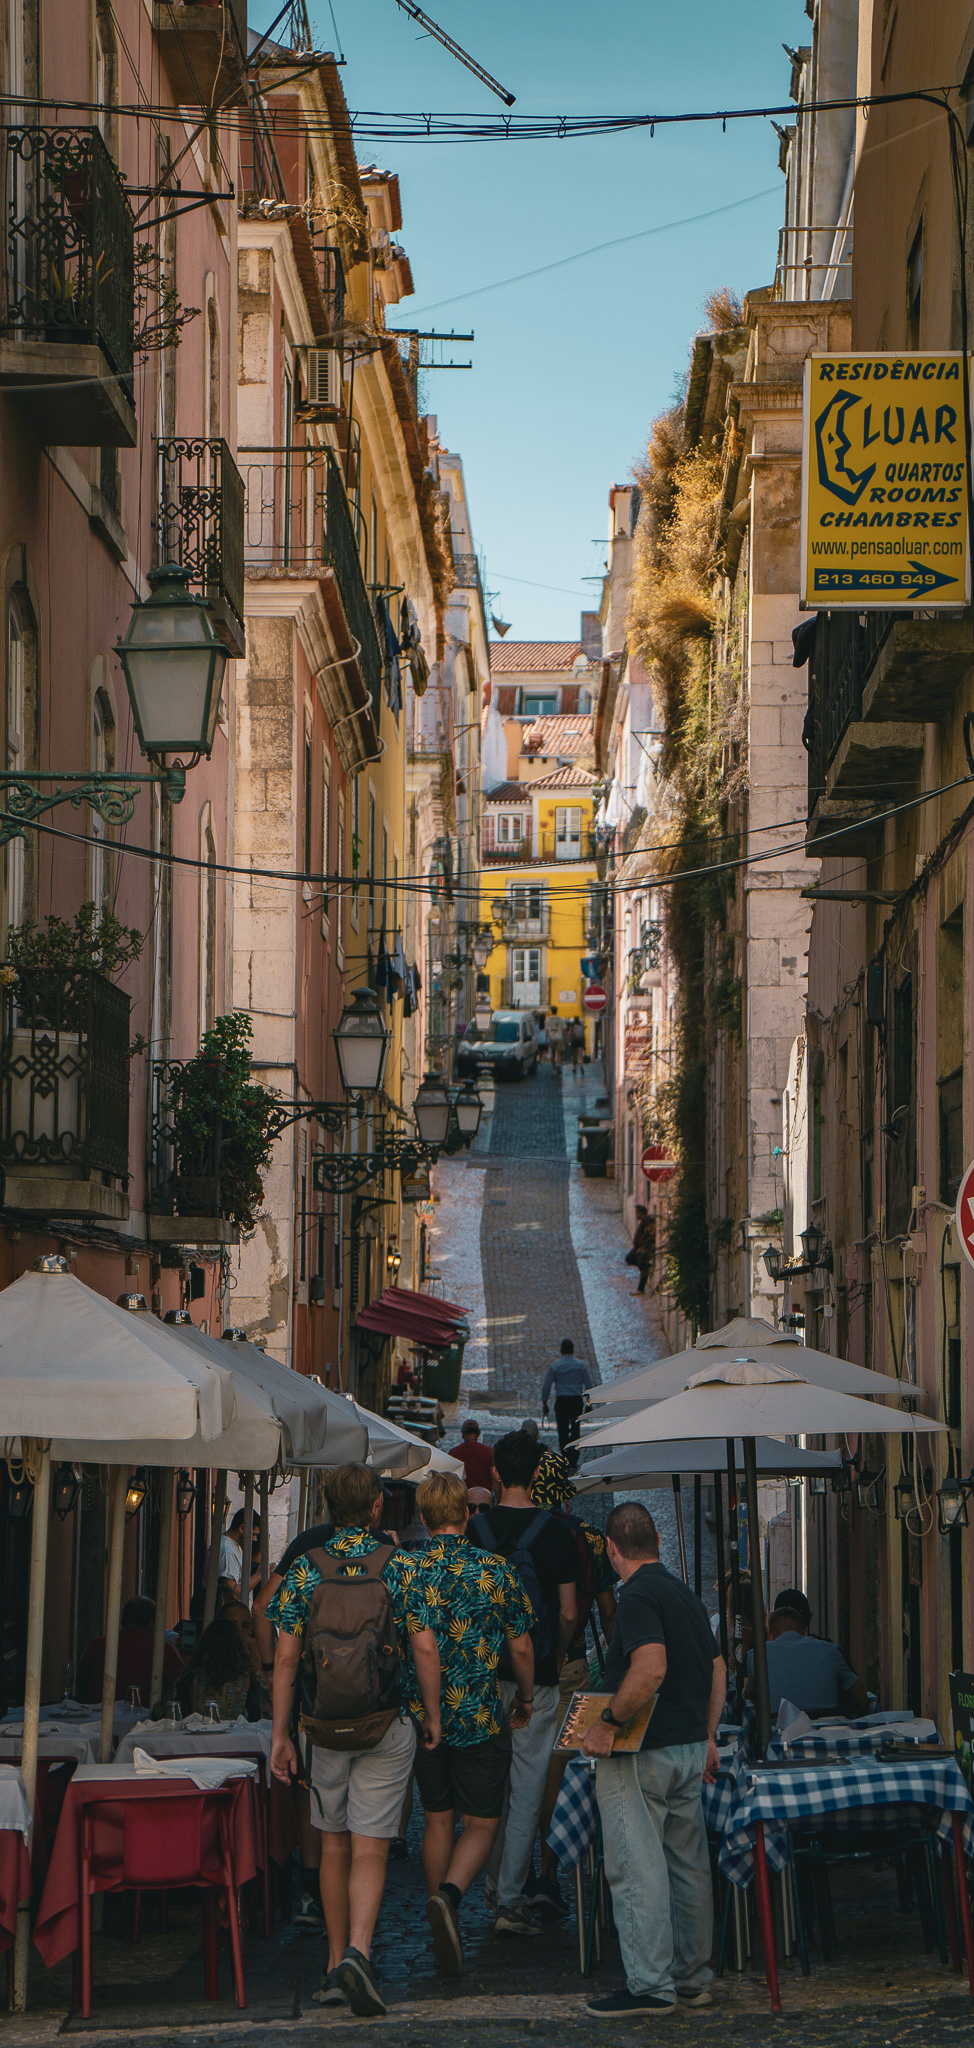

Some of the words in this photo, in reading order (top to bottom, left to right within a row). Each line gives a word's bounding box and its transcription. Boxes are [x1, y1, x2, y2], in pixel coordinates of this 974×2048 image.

[819, 360, 960, 381] RESIDÊNCIA
[863, 403, 957, 449] LUAR
[885, 462, 965, 483] QUARTOS
[869, 487, 963, 504] ROOMS
[819, 511, 962, 529] CHAMBRES
[811, 536, 963, 560] www.pensaoluar.com
[818, 574, 853, 585] 213
[859, 574, 894, 585] 460
[900, 574, 936, 586] 949
